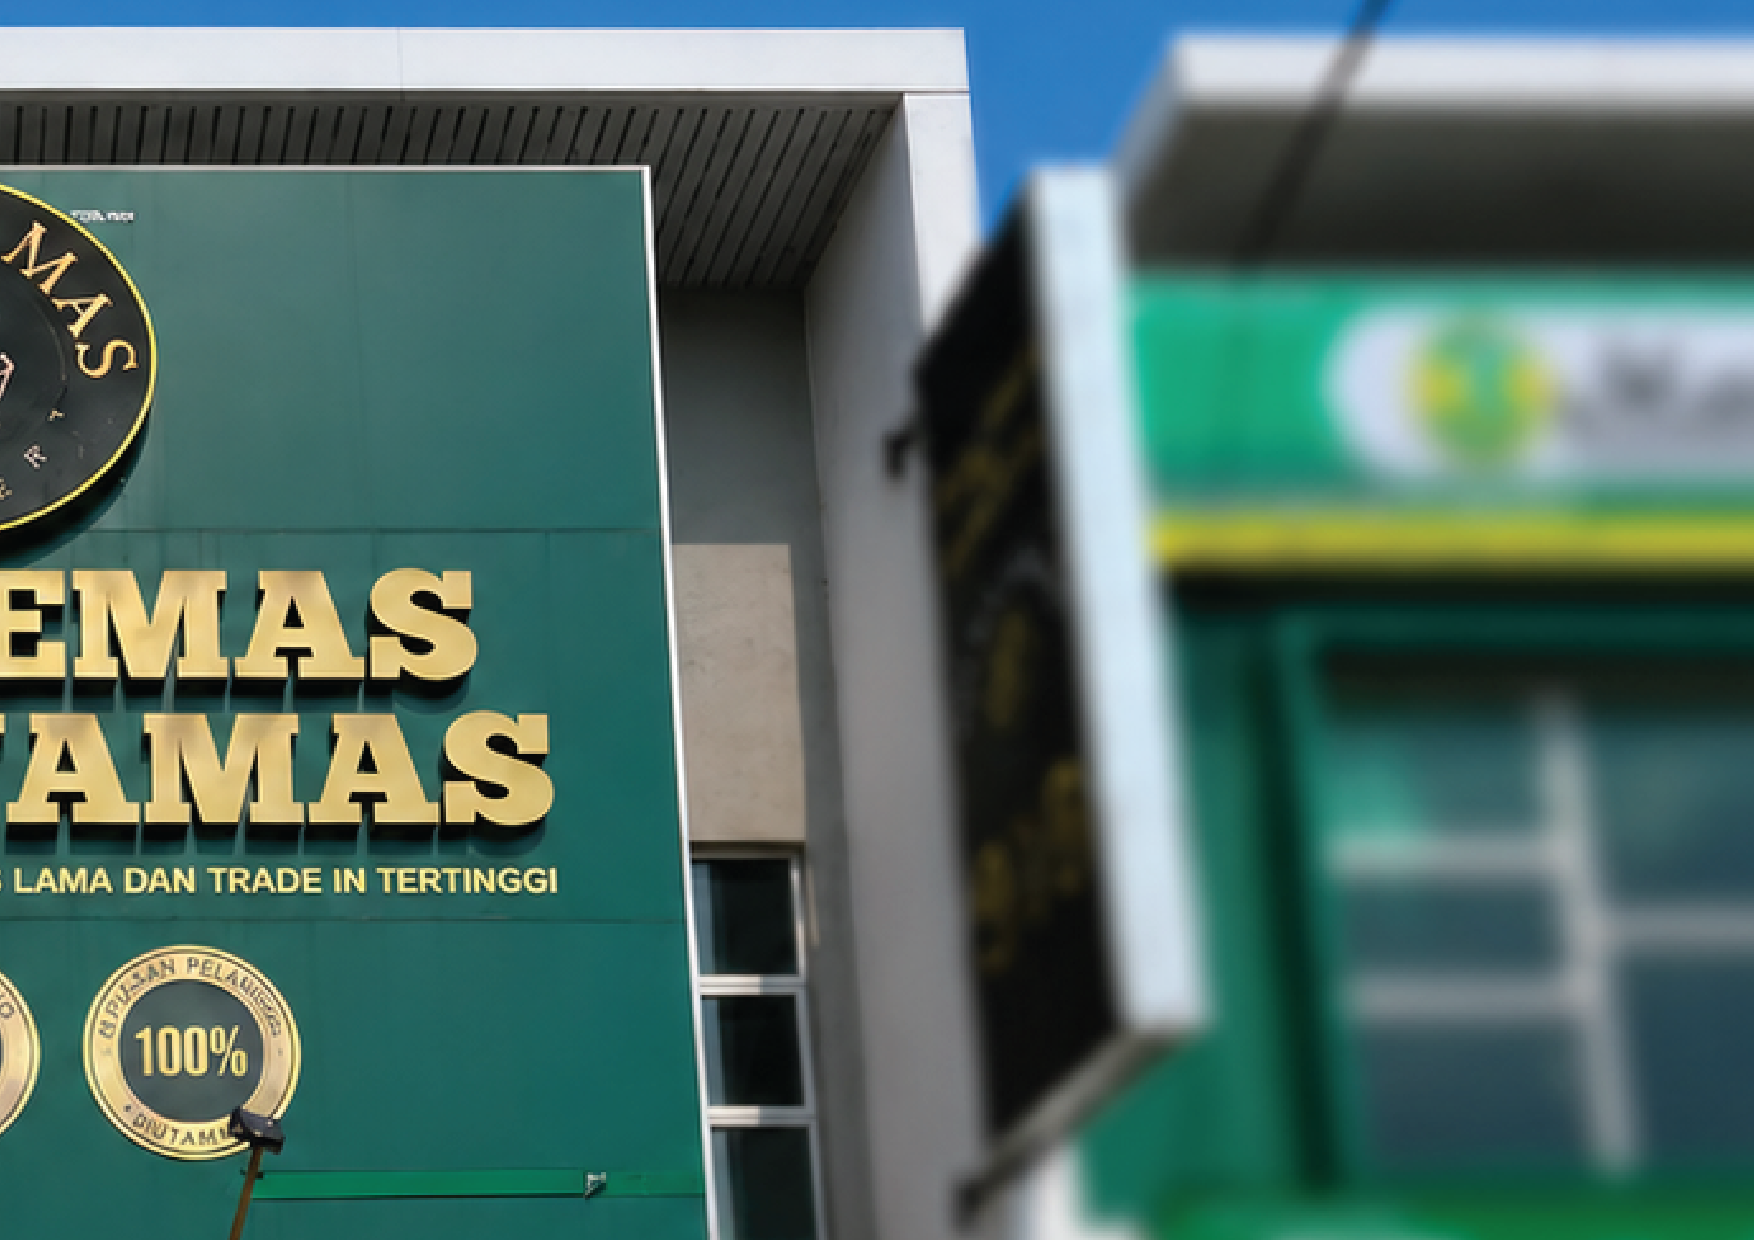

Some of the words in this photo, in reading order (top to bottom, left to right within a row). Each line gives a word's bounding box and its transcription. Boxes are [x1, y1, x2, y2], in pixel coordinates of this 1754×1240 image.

[12, 866, 115, 895] LAMA
[124, 866, 196, 895] DAN
[205, 866, 323, 895] TRADE
[332, 866, 366, 895] IN
[375, 866, 560, 895] TERTINGGI
[134, 1023, 248, 1078] 100%
